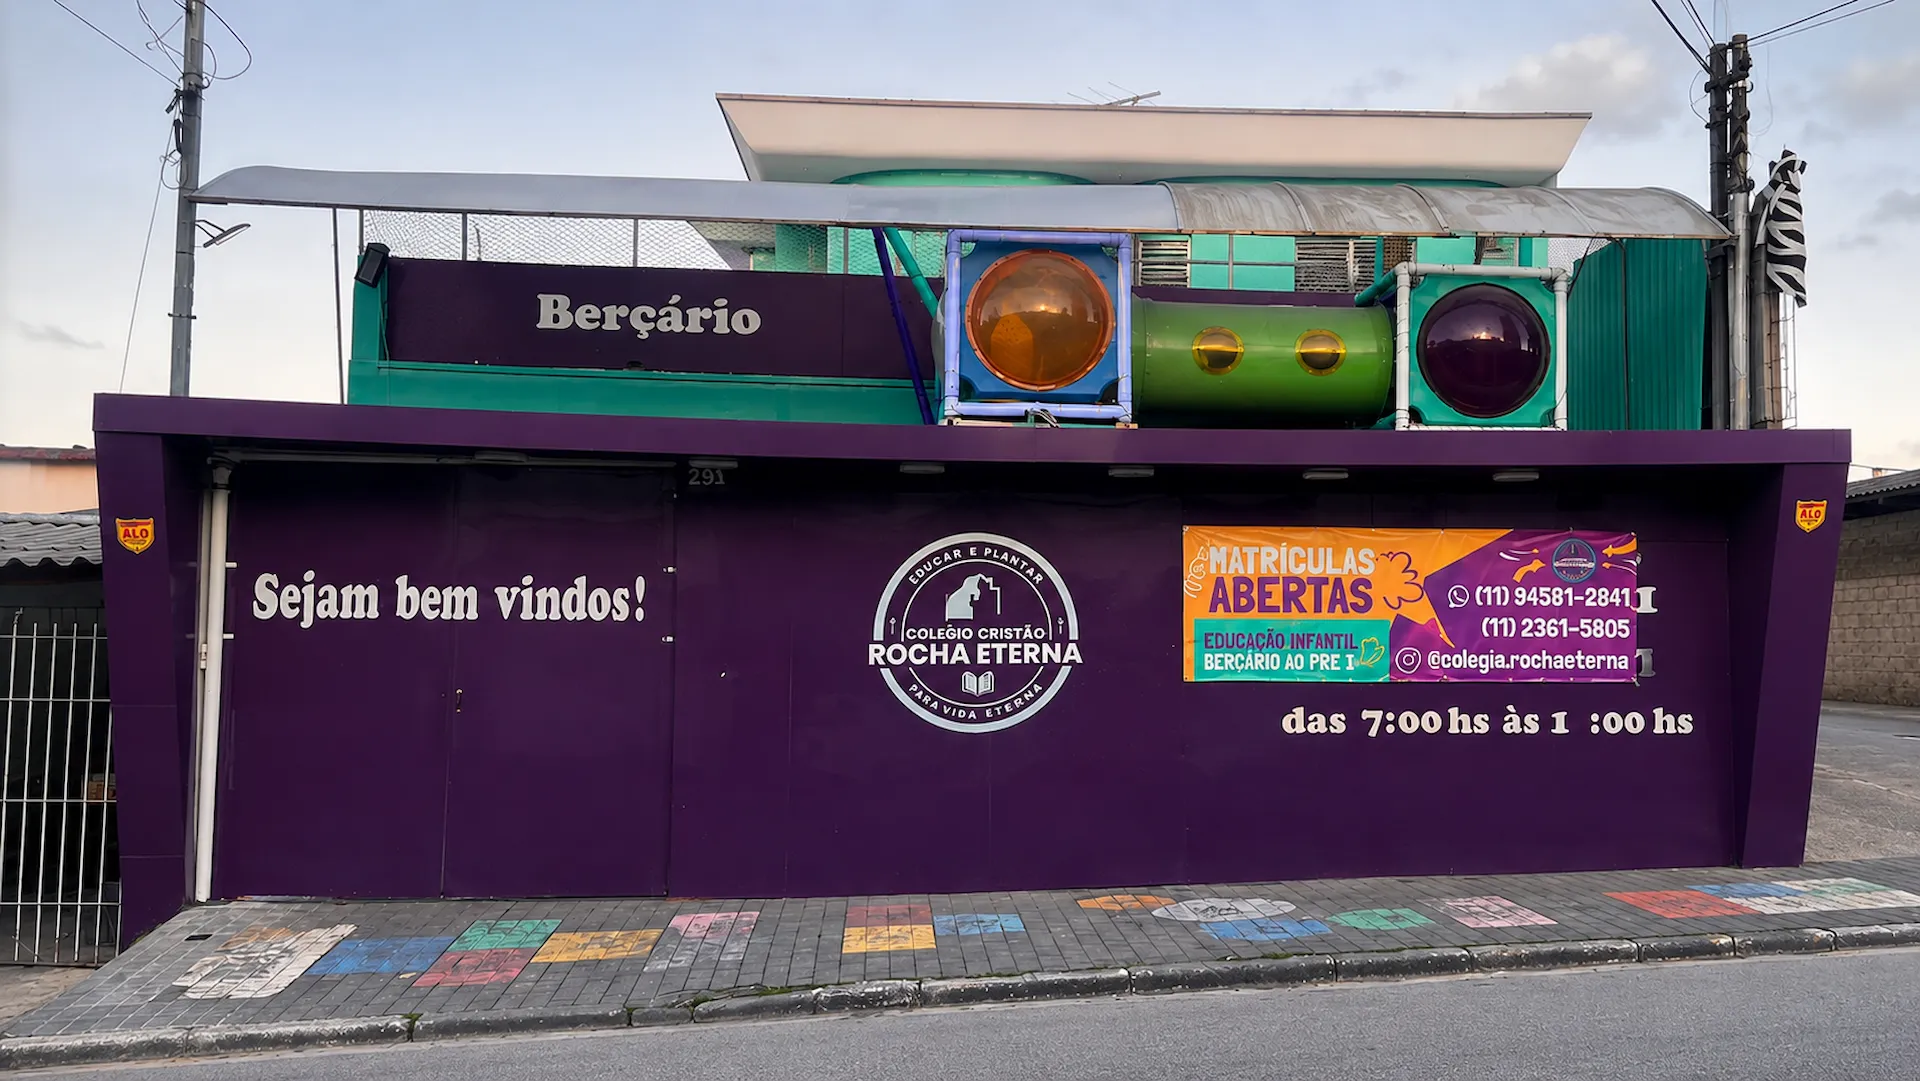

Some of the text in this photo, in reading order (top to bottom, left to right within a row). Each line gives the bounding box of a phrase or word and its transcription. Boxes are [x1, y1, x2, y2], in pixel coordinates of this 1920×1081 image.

[535, 293, 762, 340] Berçário
[688, 468, 726, 486] 291
[1800, 509, 1822, 519] ALO
[122, 528, 150, 539] ALO
[908, 547, 1044, 586] EDUCAR E PLANTAR
[1208, 542, 1377, 576] MATRÍCULAS
[252, 569, 647, 629] Sejam bem vindos!
[1208, 575, 1374, 615] ABERTAS
[1474, 585, 1631, 608] (11) 94581-2841
[977, 623, 1047, 640] CRISTÃO
[1203, 628, 1359, 653] EDUCAÇÃO INFANTIL
[1481, 617, 1630, 639] (11) 2361-5805
[868, 642, 1084, 666] ROCHA ETERNA
[1203, 649, 1281, 674] BERÇÁRIO
[1284, 653, 1306, 671] AO
[1309, 653, 1341, 671] PRE
[908, 682, 1043, 721] PARA VIDA ETERNA
[1281, 706, 1347, 735] das
[1361, 709, 1443, 738] 7:00
[1447, 706, 1490, 735] hs
[1502, 704, 1541, 734] às
[1652, 706, 1694, 735] hs
